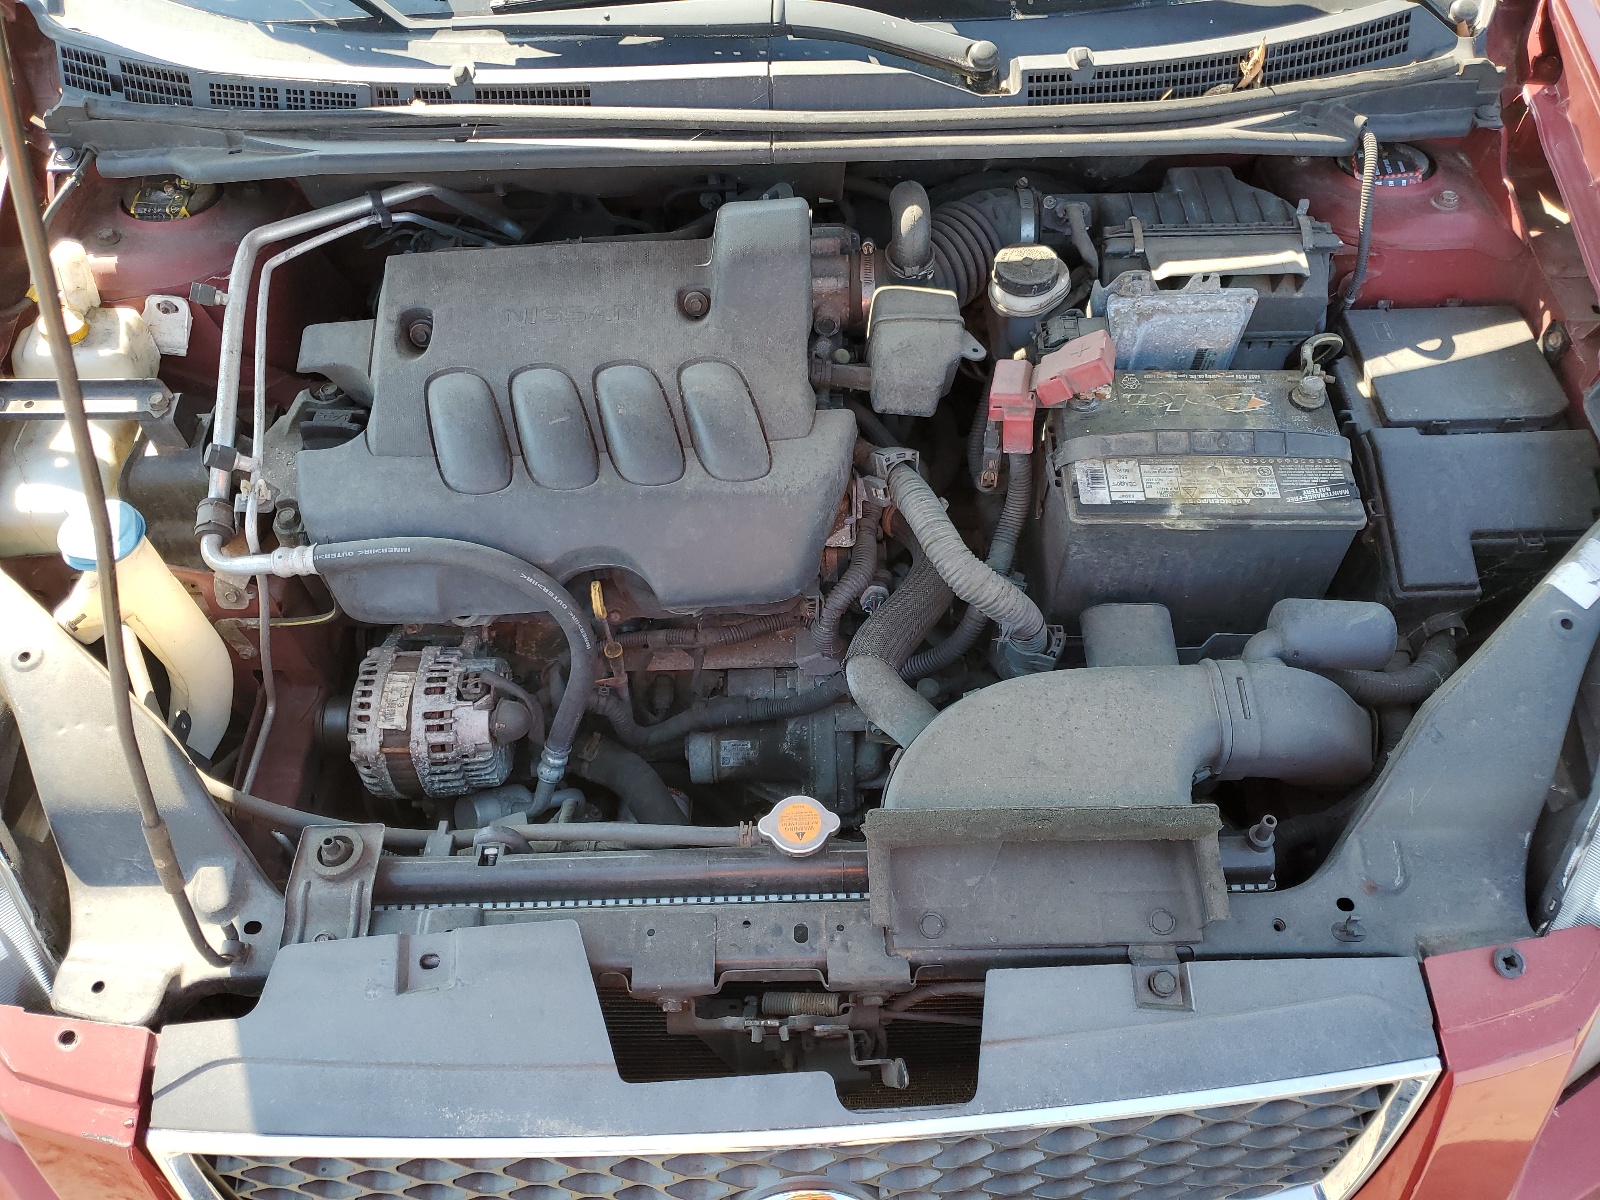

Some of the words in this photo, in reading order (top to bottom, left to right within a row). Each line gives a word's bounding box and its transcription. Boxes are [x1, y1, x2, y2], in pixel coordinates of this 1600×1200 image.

[502, 304, 640, 325] NISSAN
[1285, 488, 1350, 503] MAINTENANCE-FREE
[1302, 486, 1331, 496] BATTERY
